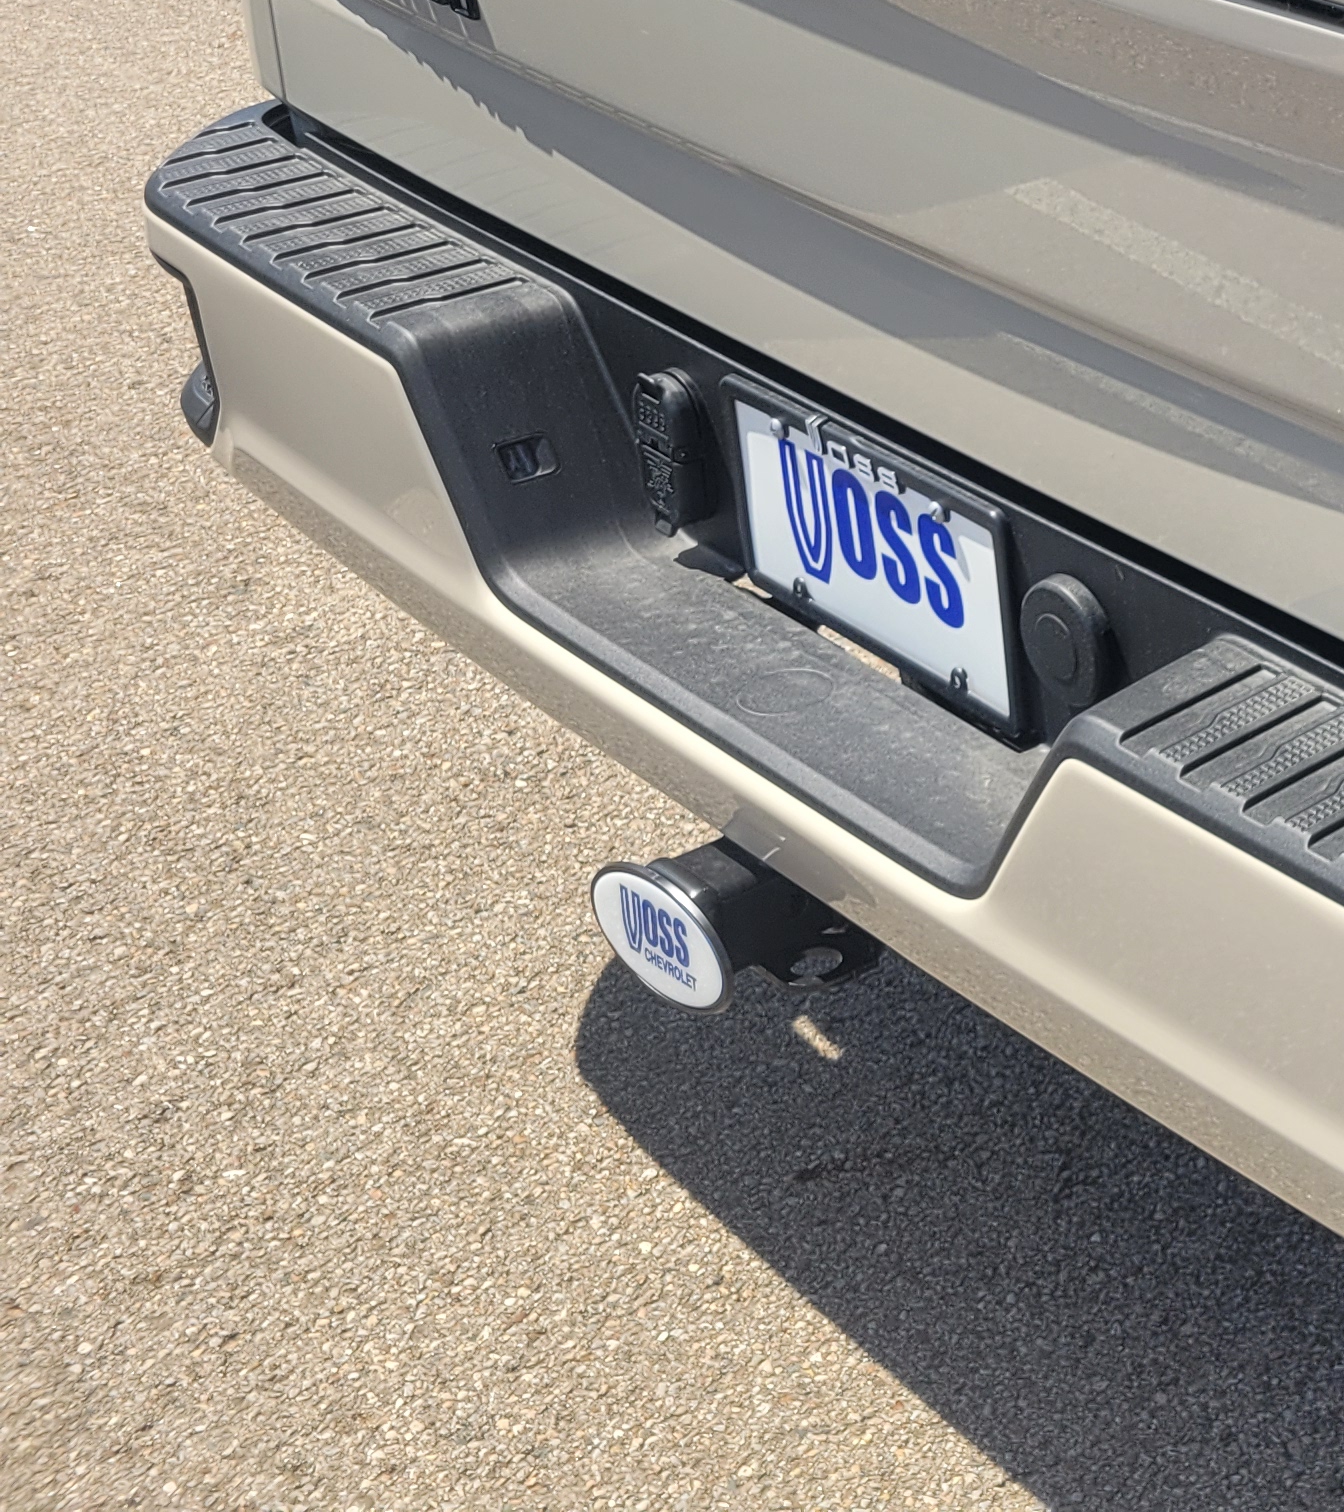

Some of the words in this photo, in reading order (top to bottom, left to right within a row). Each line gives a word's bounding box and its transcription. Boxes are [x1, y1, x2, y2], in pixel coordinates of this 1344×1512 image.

[805, 413, 900, 495] VOSS
[778, 437, 965, 628] VOSS
[619, 883, 690, 968] VOSS
[644, 947, 697, 992] CHEVROLET
